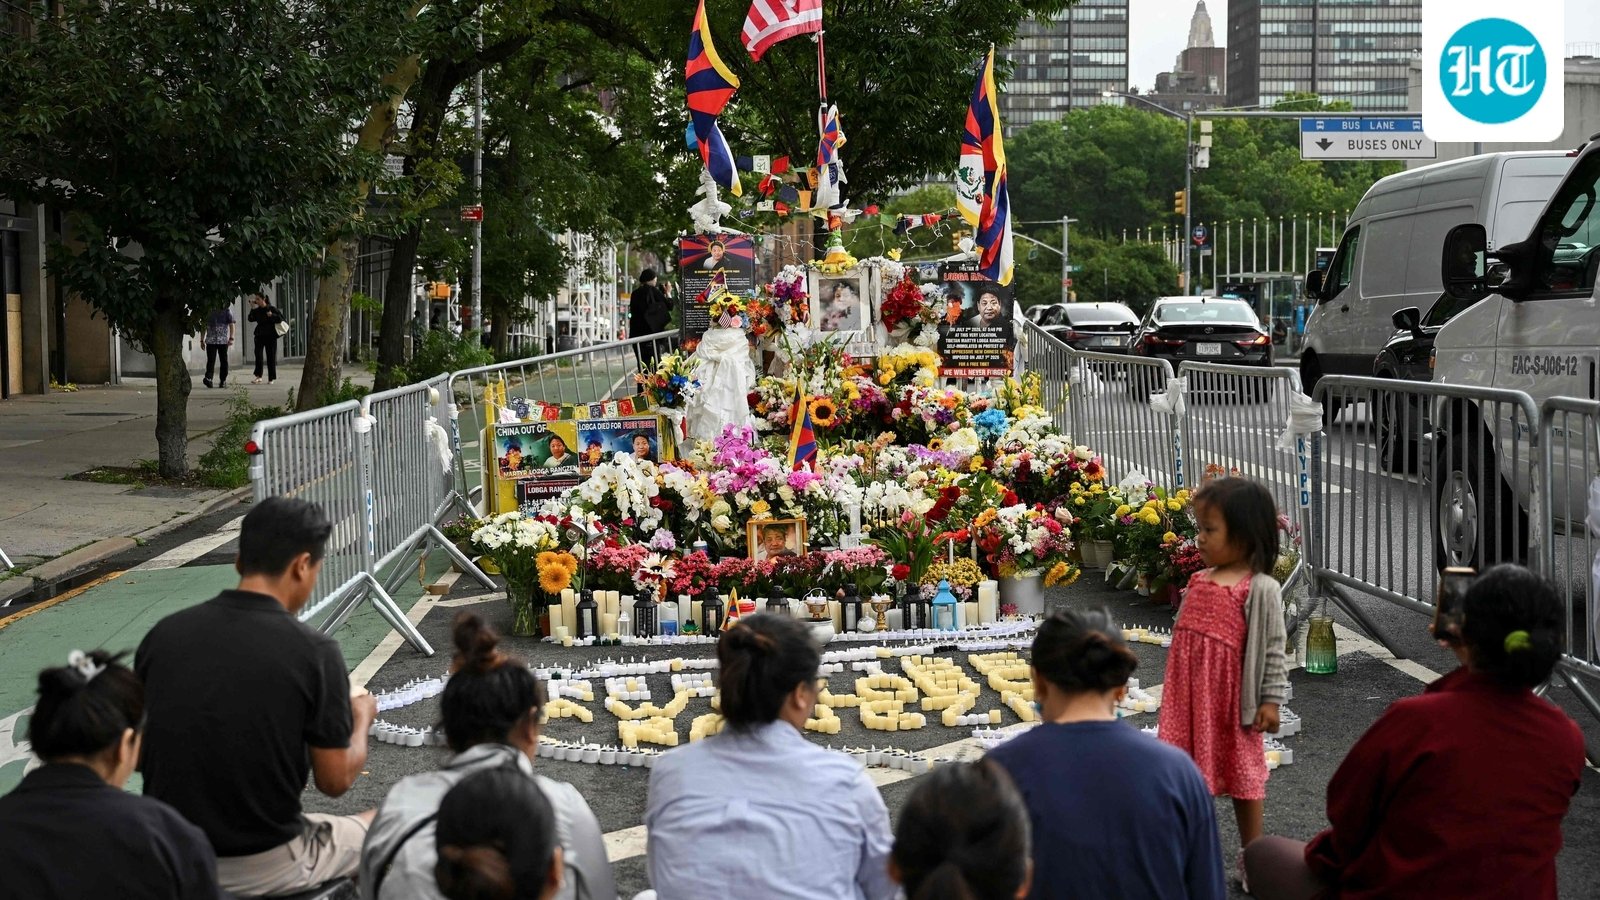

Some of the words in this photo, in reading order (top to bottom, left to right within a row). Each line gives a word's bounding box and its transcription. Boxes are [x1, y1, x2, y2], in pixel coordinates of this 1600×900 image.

[1342, 121, 1360, 130] BUS
[1370, 121, 1394, 130] LANE
[1348, 140, 1386, 150] BUSES
[1392, 140, 1422, 150] ONLY
[1512, 356, 1577, 376] FAC-S-006-12
[497, 427, 520, 436] CHINA
[521, 425, 536, 434] OUT
[537, 424, 547, 432] OF
[1175, 434, 1184, 485] NYPD
[504, 469, 528, 478] MARTYR
[529, 467, 549, 475] LOBGA
[550, 465, 578, 473] RANGZEN
[1298, 438, 1308, 505] NYPD
